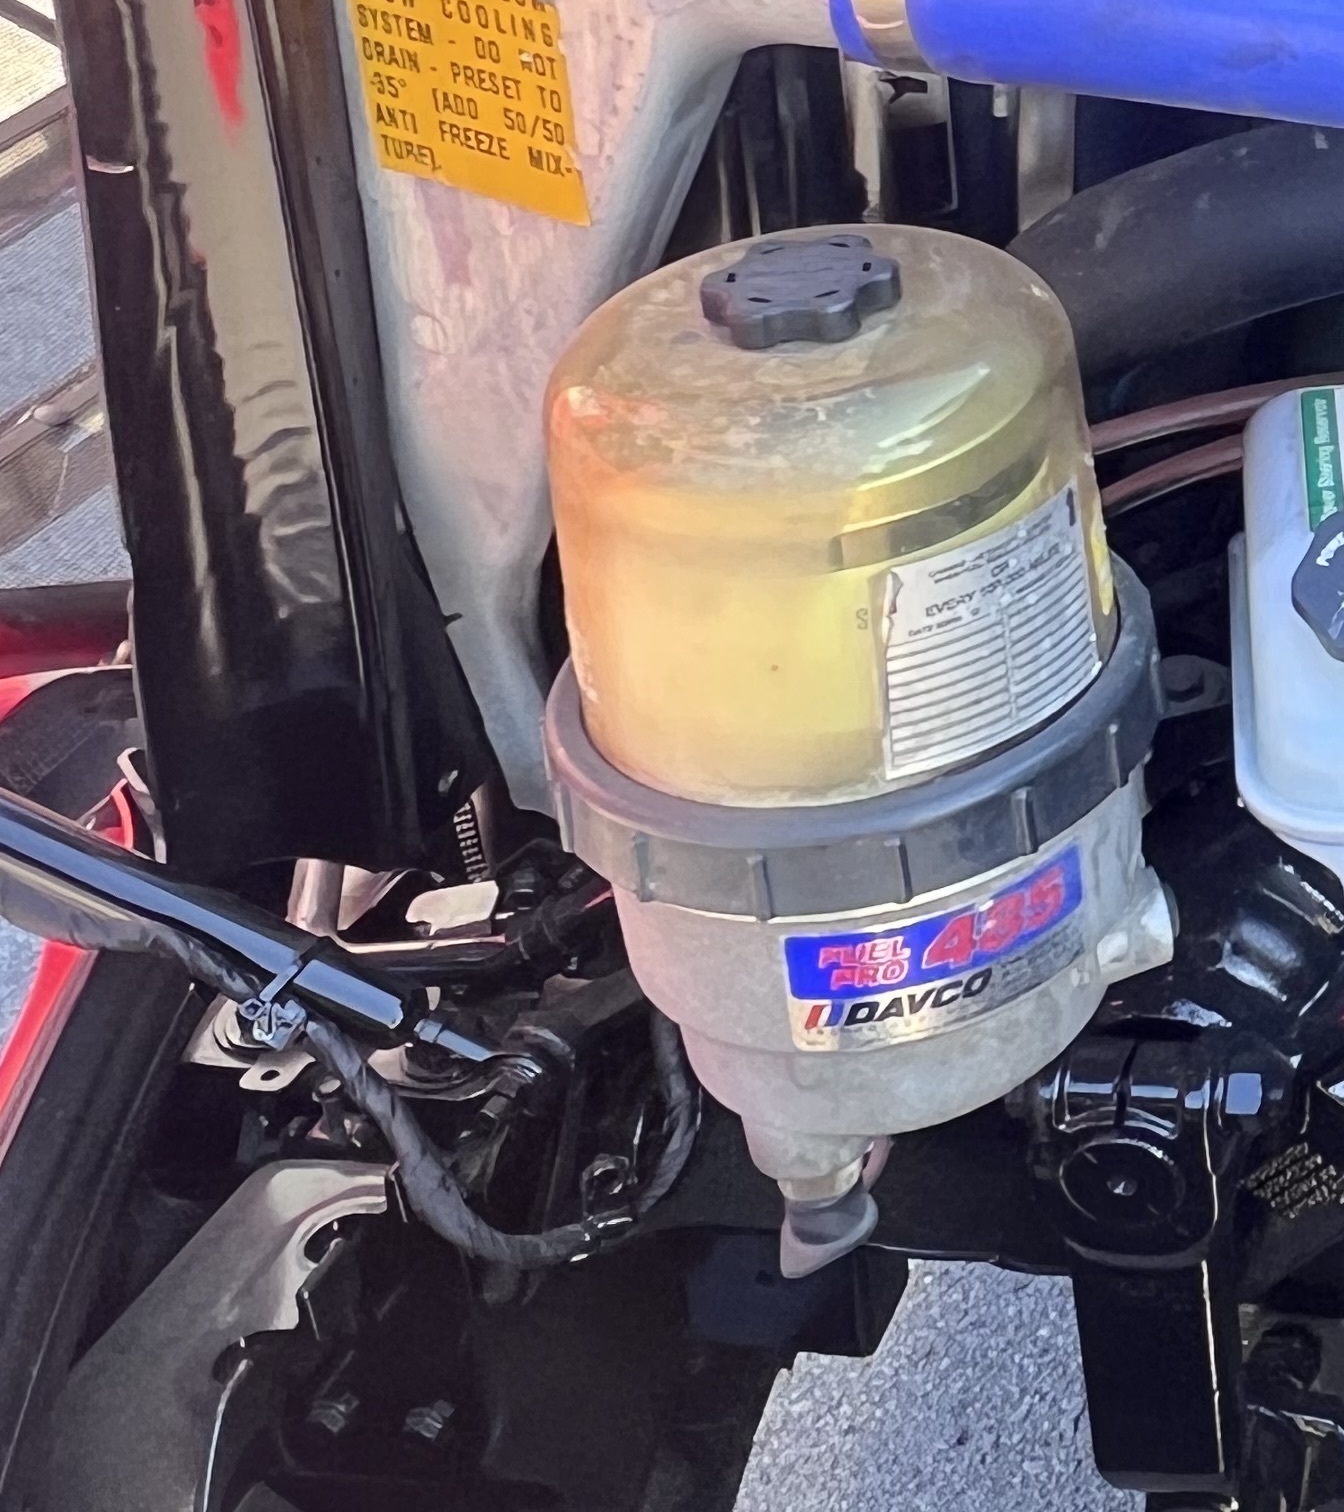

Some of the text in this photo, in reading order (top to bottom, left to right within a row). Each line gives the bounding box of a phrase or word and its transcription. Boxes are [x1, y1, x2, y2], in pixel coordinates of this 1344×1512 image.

[357, 3, 434, 45] SYSTEM
[474, 35, 500, 64] DO
[362, 36, 420, 74] DRAIN
[451, 61, 522, 101] PRESET
[537, 85, 562, 113] TO
[376, 102, 418, 134] ANTI
[439, 120, 510, 160] FREEZE
[503, 107, 565, 146] 50/50
[818, 936, 911, 968] FUEL
[831, 959, 910, 991] PRO
[844, 967, 993, 1026] DAVCO
